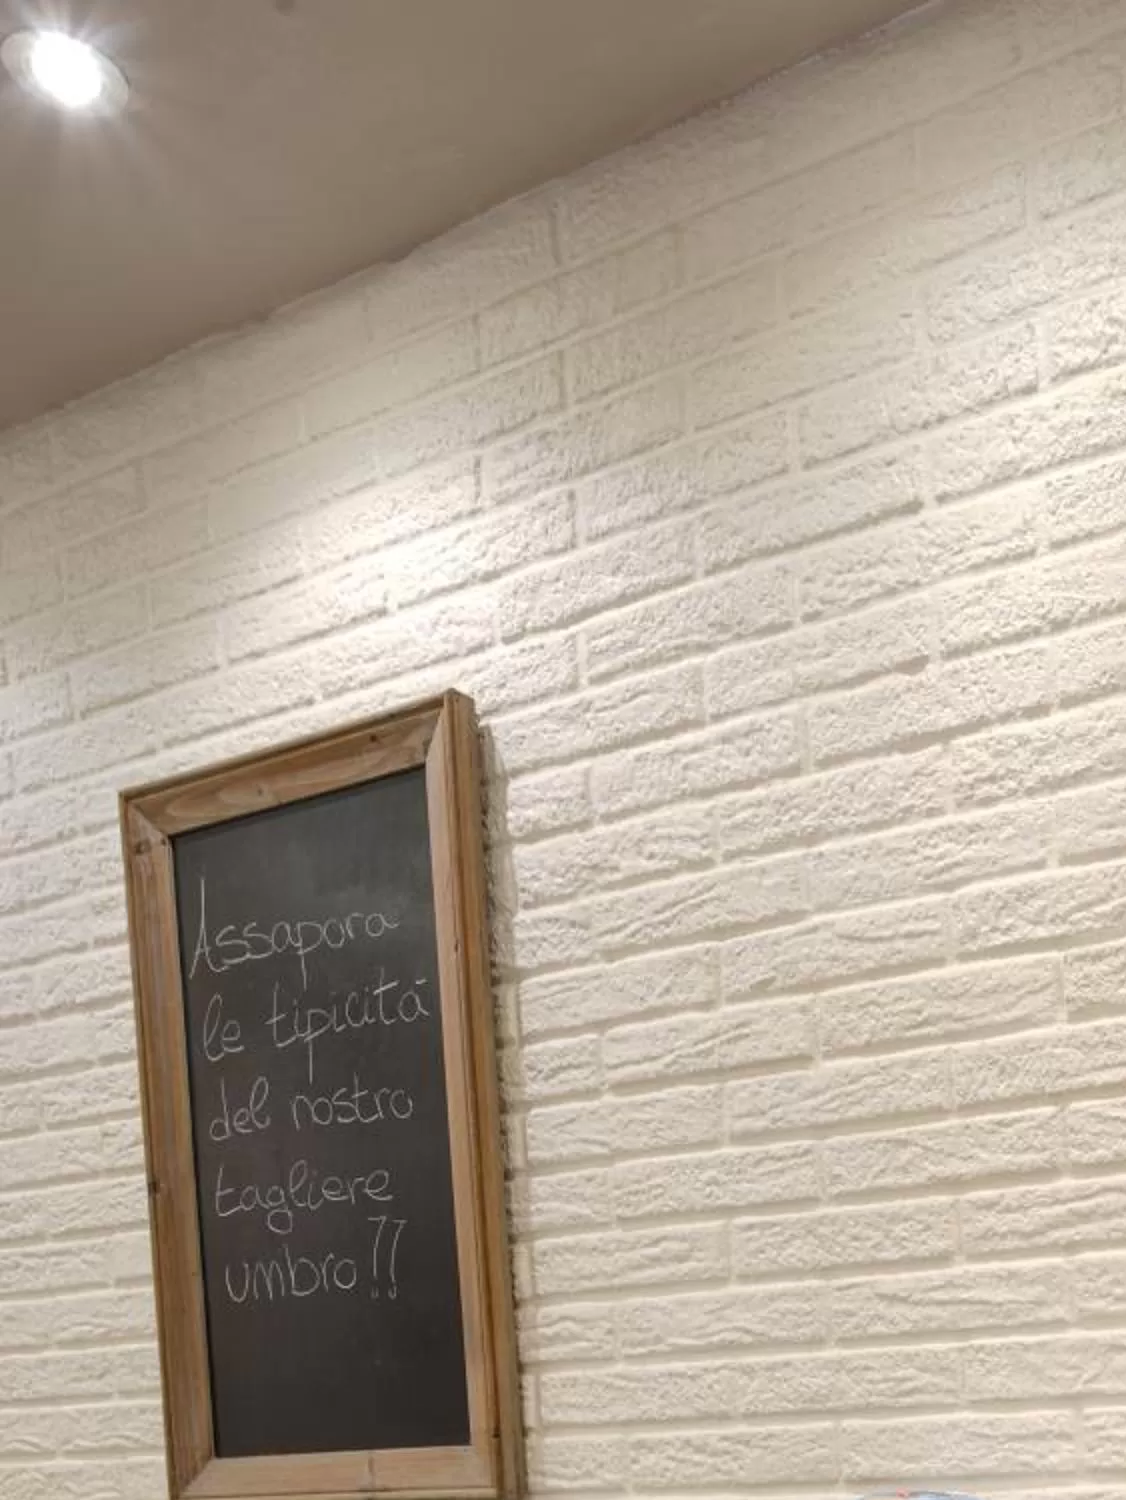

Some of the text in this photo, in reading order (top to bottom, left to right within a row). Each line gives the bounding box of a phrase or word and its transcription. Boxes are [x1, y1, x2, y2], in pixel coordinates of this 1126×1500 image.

[189, 879, 399, 990] Assapora
[203, 993, 245, 1061] le
[209, 1071, 413, 1141] del nostro
[215, 1159, 393, 1235] tagliere
